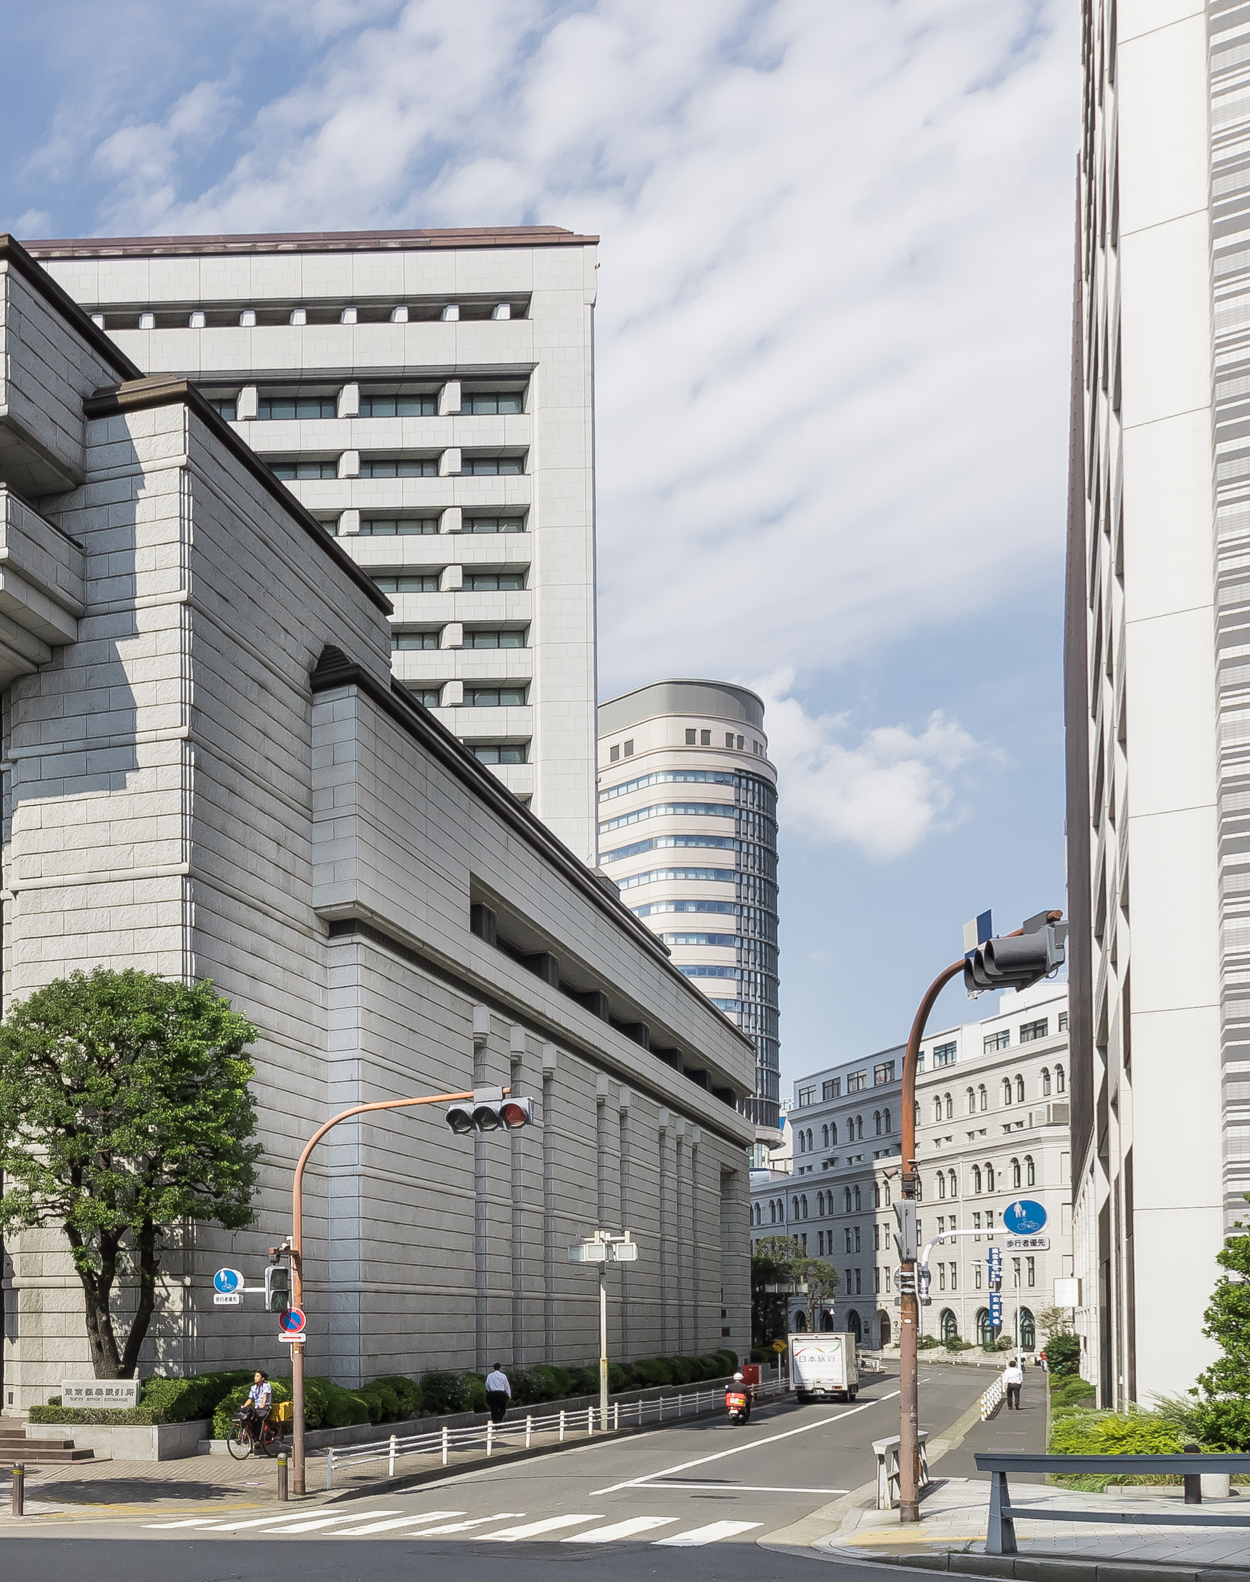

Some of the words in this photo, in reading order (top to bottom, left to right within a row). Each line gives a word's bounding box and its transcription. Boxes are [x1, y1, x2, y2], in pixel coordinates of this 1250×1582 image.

[1006, 1238, 1046, 1248] 歩行者優先
[798, 1355, 835, 1363] 日本旅行
